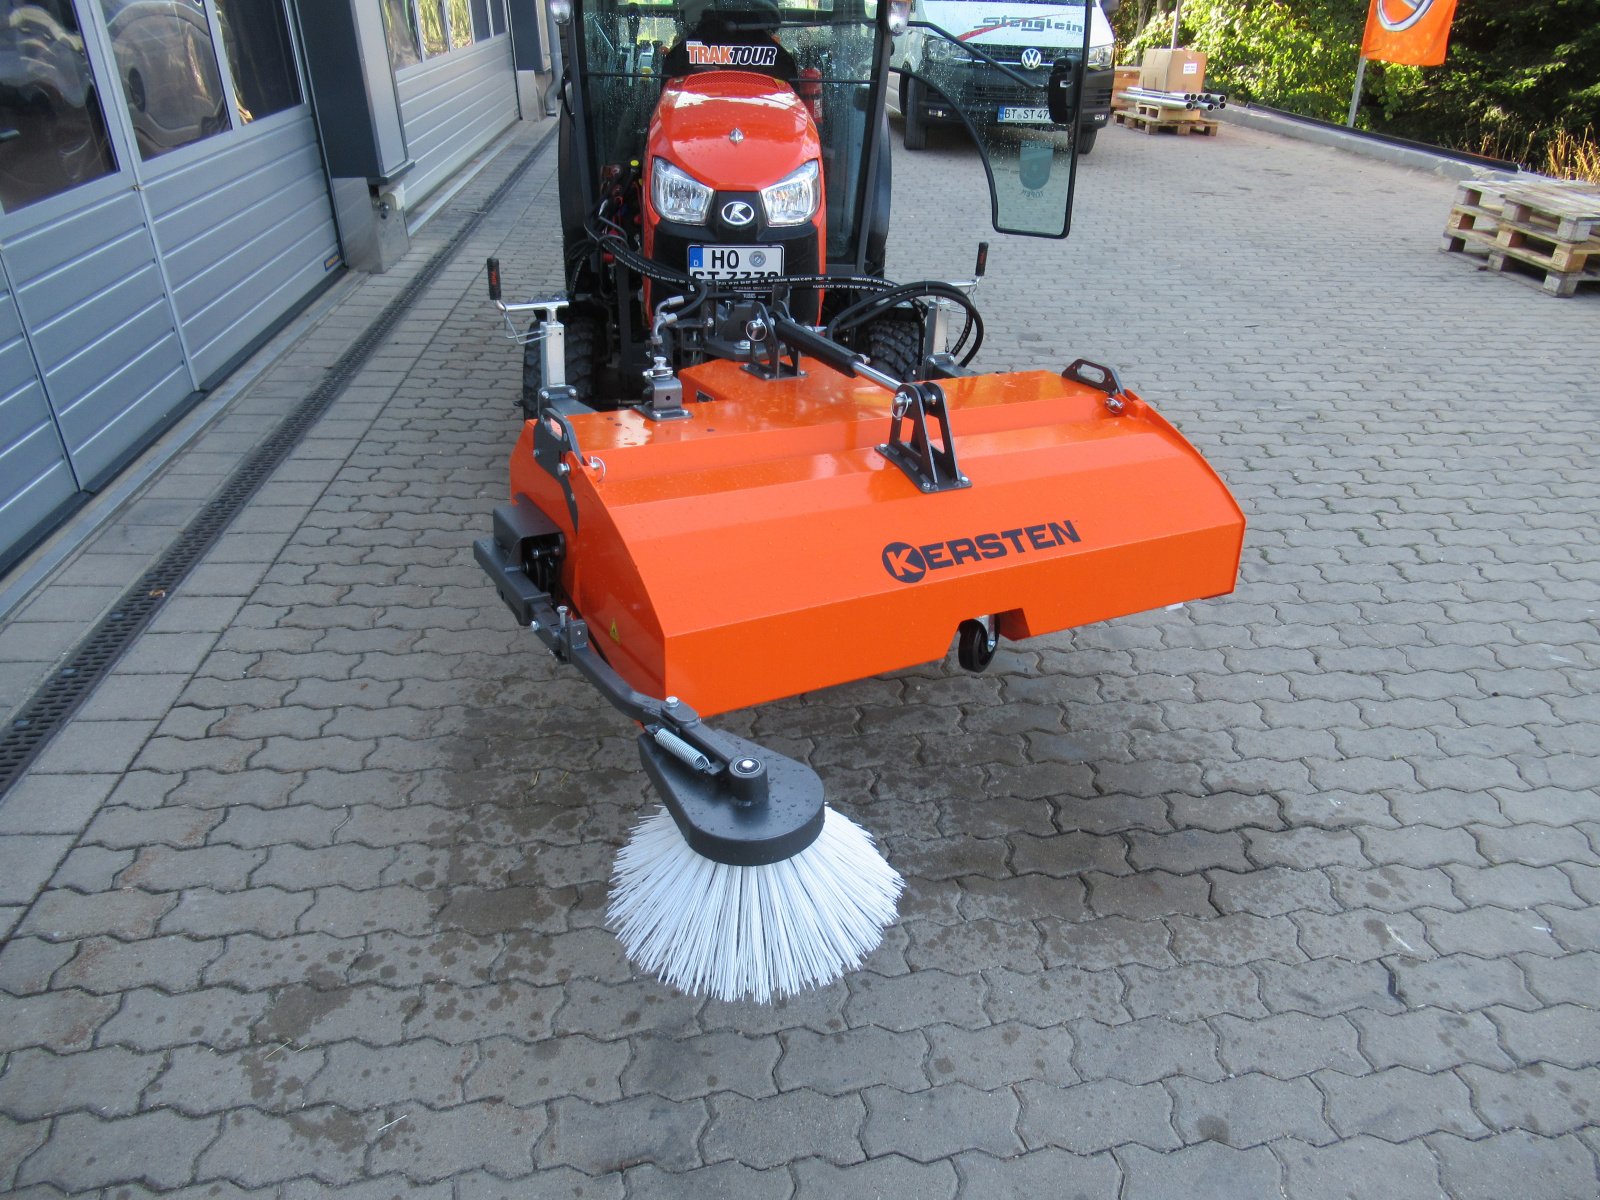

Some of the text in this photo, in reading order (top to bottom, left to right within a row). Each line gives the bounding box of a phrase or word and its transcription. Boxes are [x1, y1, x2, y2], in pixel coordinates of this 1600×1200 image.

[974, 15, 1083, 33] Stenglein
[687, 45, 776, 65] TRAKTOUR
[1004, 108, 1017, 119] BT
[1023, 109, 1035, 119] ST
[693, 259, 699, 267] D
[711, 249, 740, 270] HO
[881, 519, 1082, 584] KERSTEN
